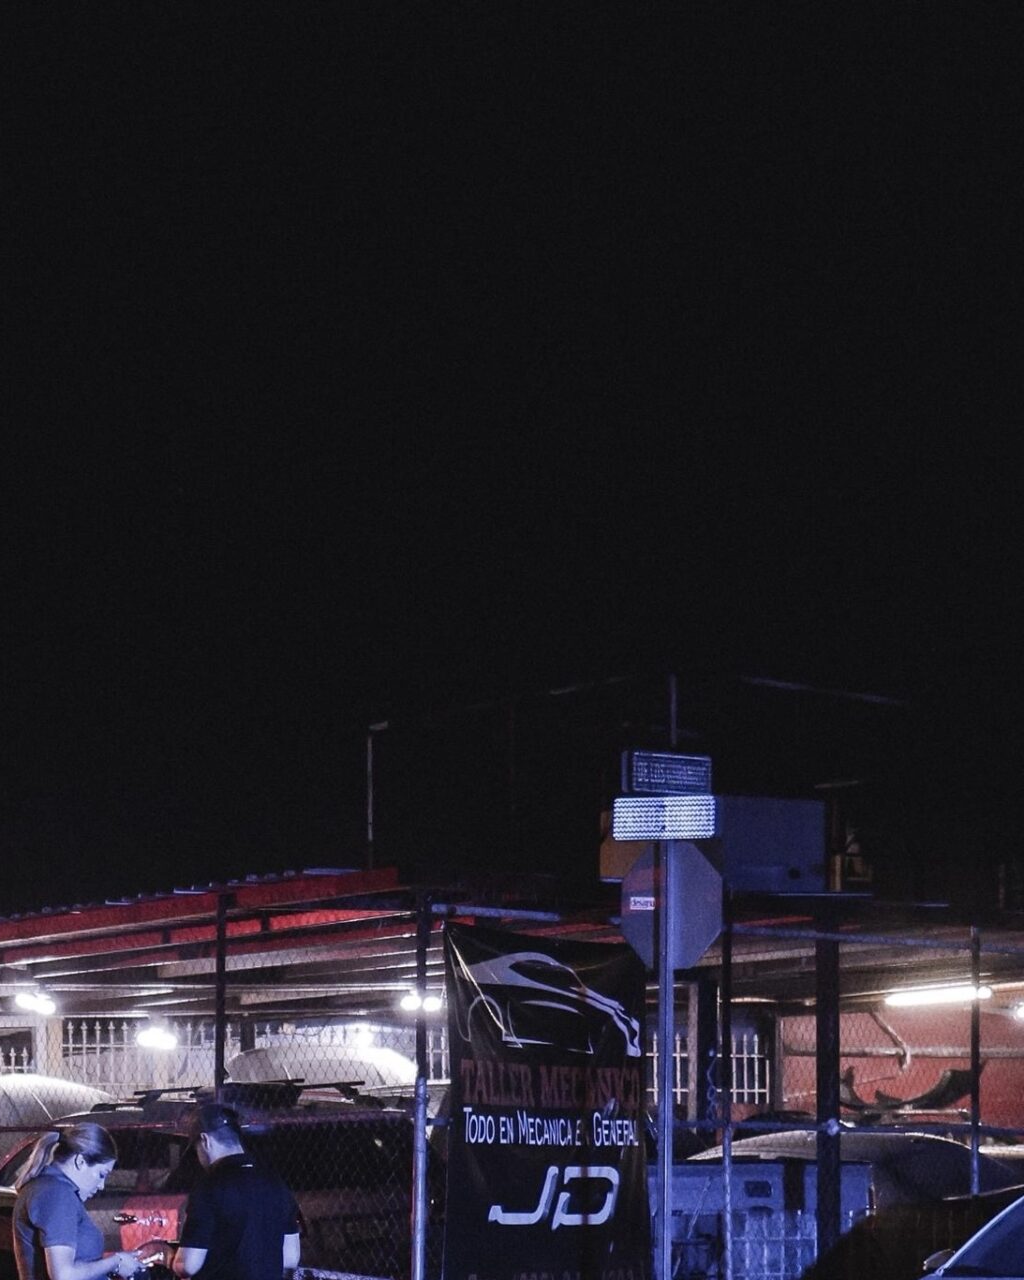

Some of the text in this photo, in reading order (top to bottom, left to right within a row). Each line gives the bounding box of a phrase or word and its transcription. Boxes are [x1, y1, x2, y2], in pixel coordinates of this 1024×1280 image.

[460, 1058, 535, 1107] TALLER
[499, 1116, 514, 1145] EN
[517, 1110, 573, 1147] MECANICA
[593, 1111, 639, 1147] GENERAL
[488, 1165, 621, 1232] JD
